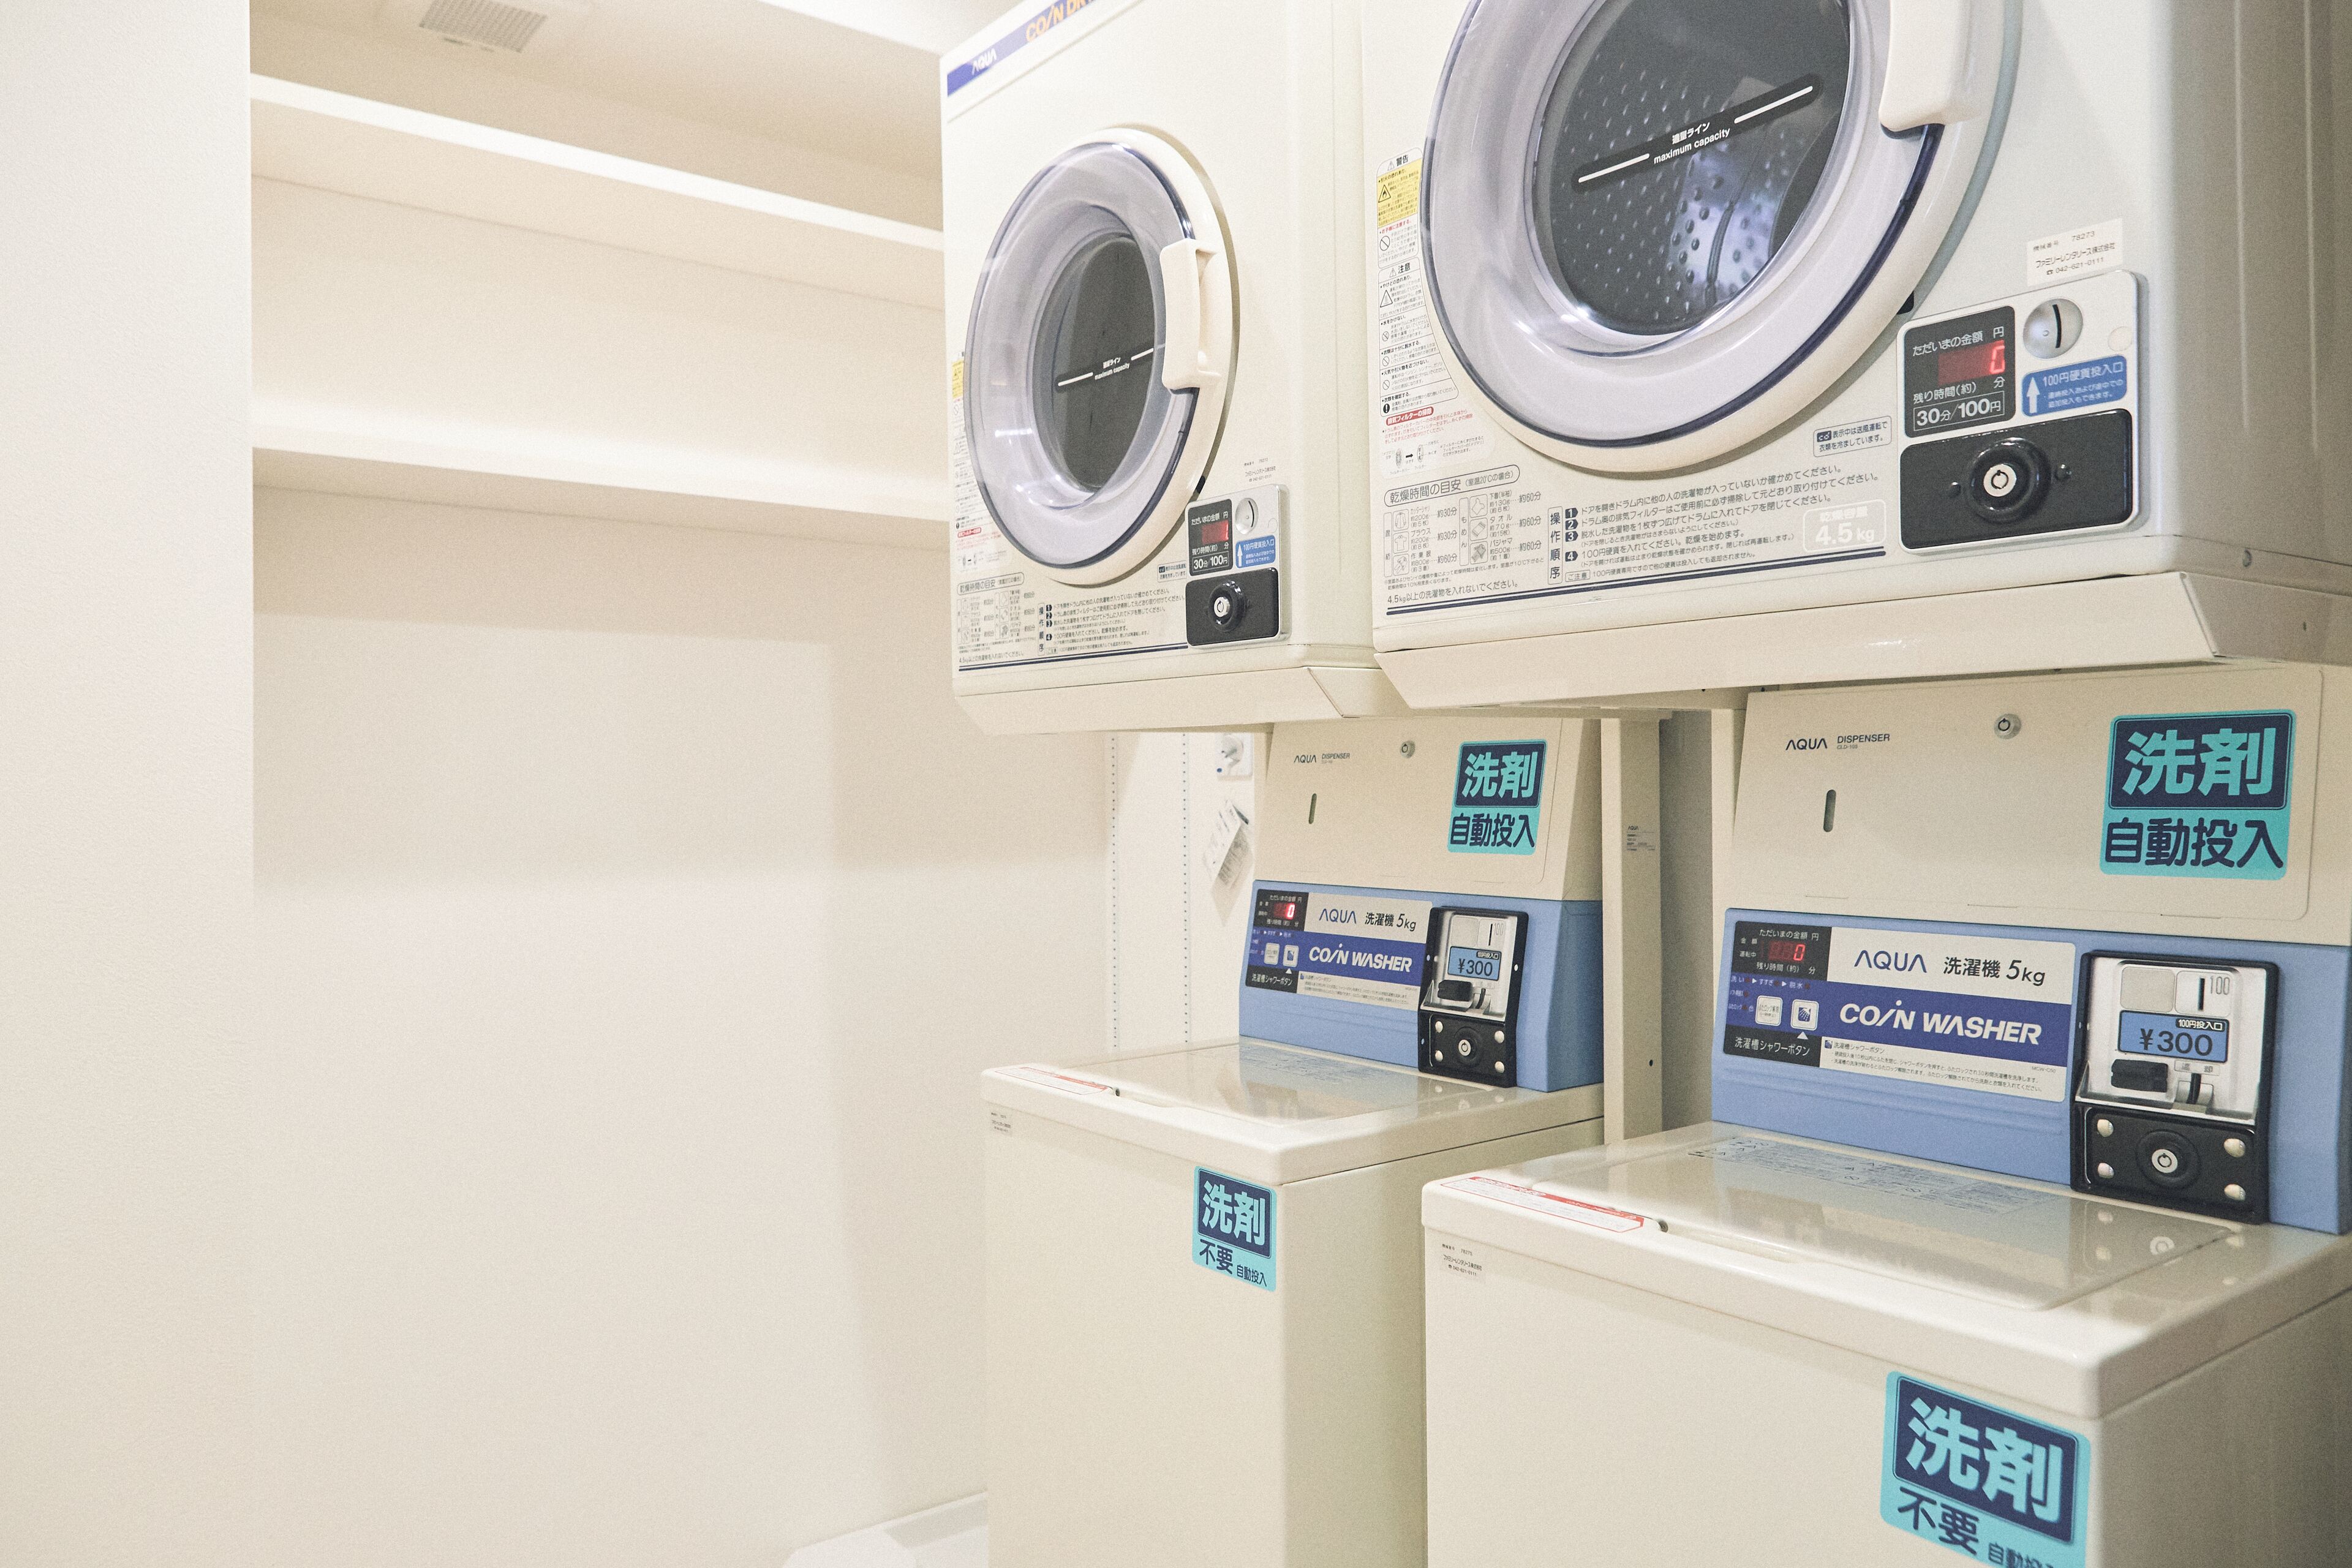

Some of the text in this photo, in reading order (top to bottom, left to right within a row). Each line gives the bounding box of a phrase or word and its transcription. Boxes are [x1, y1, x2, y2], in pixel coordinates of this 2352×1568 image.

[971, 48, 997, 75] AQUA
[1654, 128, 1730, 164] maximum capacity
[1396, 154, 1409, 167] 警告
[1398, 263, 1410, 274] 注意
[1913, 326, 2004, 356] ただいまの金額 円
[1913, 376, 2005, 404] 残り時間(約) 分
[1390, 479, 1461, 504] 乾燥時間の目安
[1785, 733, 1890, 750] AQUA DISPENSER
[1294, 754, 1316, 763] AQUA
[2122, 726, 2277, 797] 洗剤
[1463, 751, 1538, 798] 洗剤
[1449, 812, 1535, 848] 自動投入
[2105, 817, 2285, 869] 自動投入
[1287, 904, 1295, 918] 0
[1319, 908, 1357, 924] AQUA
[1365, 911, 1395, 927] 洗濯機
[1493, 922, 1504, 937] 100
[1759, 929, 1819, 941] ただいまの金額 円
[1309, 943, 1412, 973] COIN WASHER
[1793, 944, 1806, 962] 0
[1854, 949, 1928, 974] AQUA
[1943, 956, 2001, 979] 洗濯機
[1458, 957, 1493, 977] ¥300
[2209, 976, 2231, 995] 100
[1839, 1000, 2042, 1046] COIN WASHER
[2178, 1019, 2223, 1031] 100円投入口
[1735, 1036, 1811, 1056] 洗濯槽シャワーボタン
[2139, 1027, 2213, 1057] ¥300
[1202, 1180, 1265, 1246] 洗剤
[1199, 1238, 1267, 1287] 不要 自動投入
[1905, 1396, 2063, 1524] 洗剤
[1898, 1486, 1980, 1556] 不要
